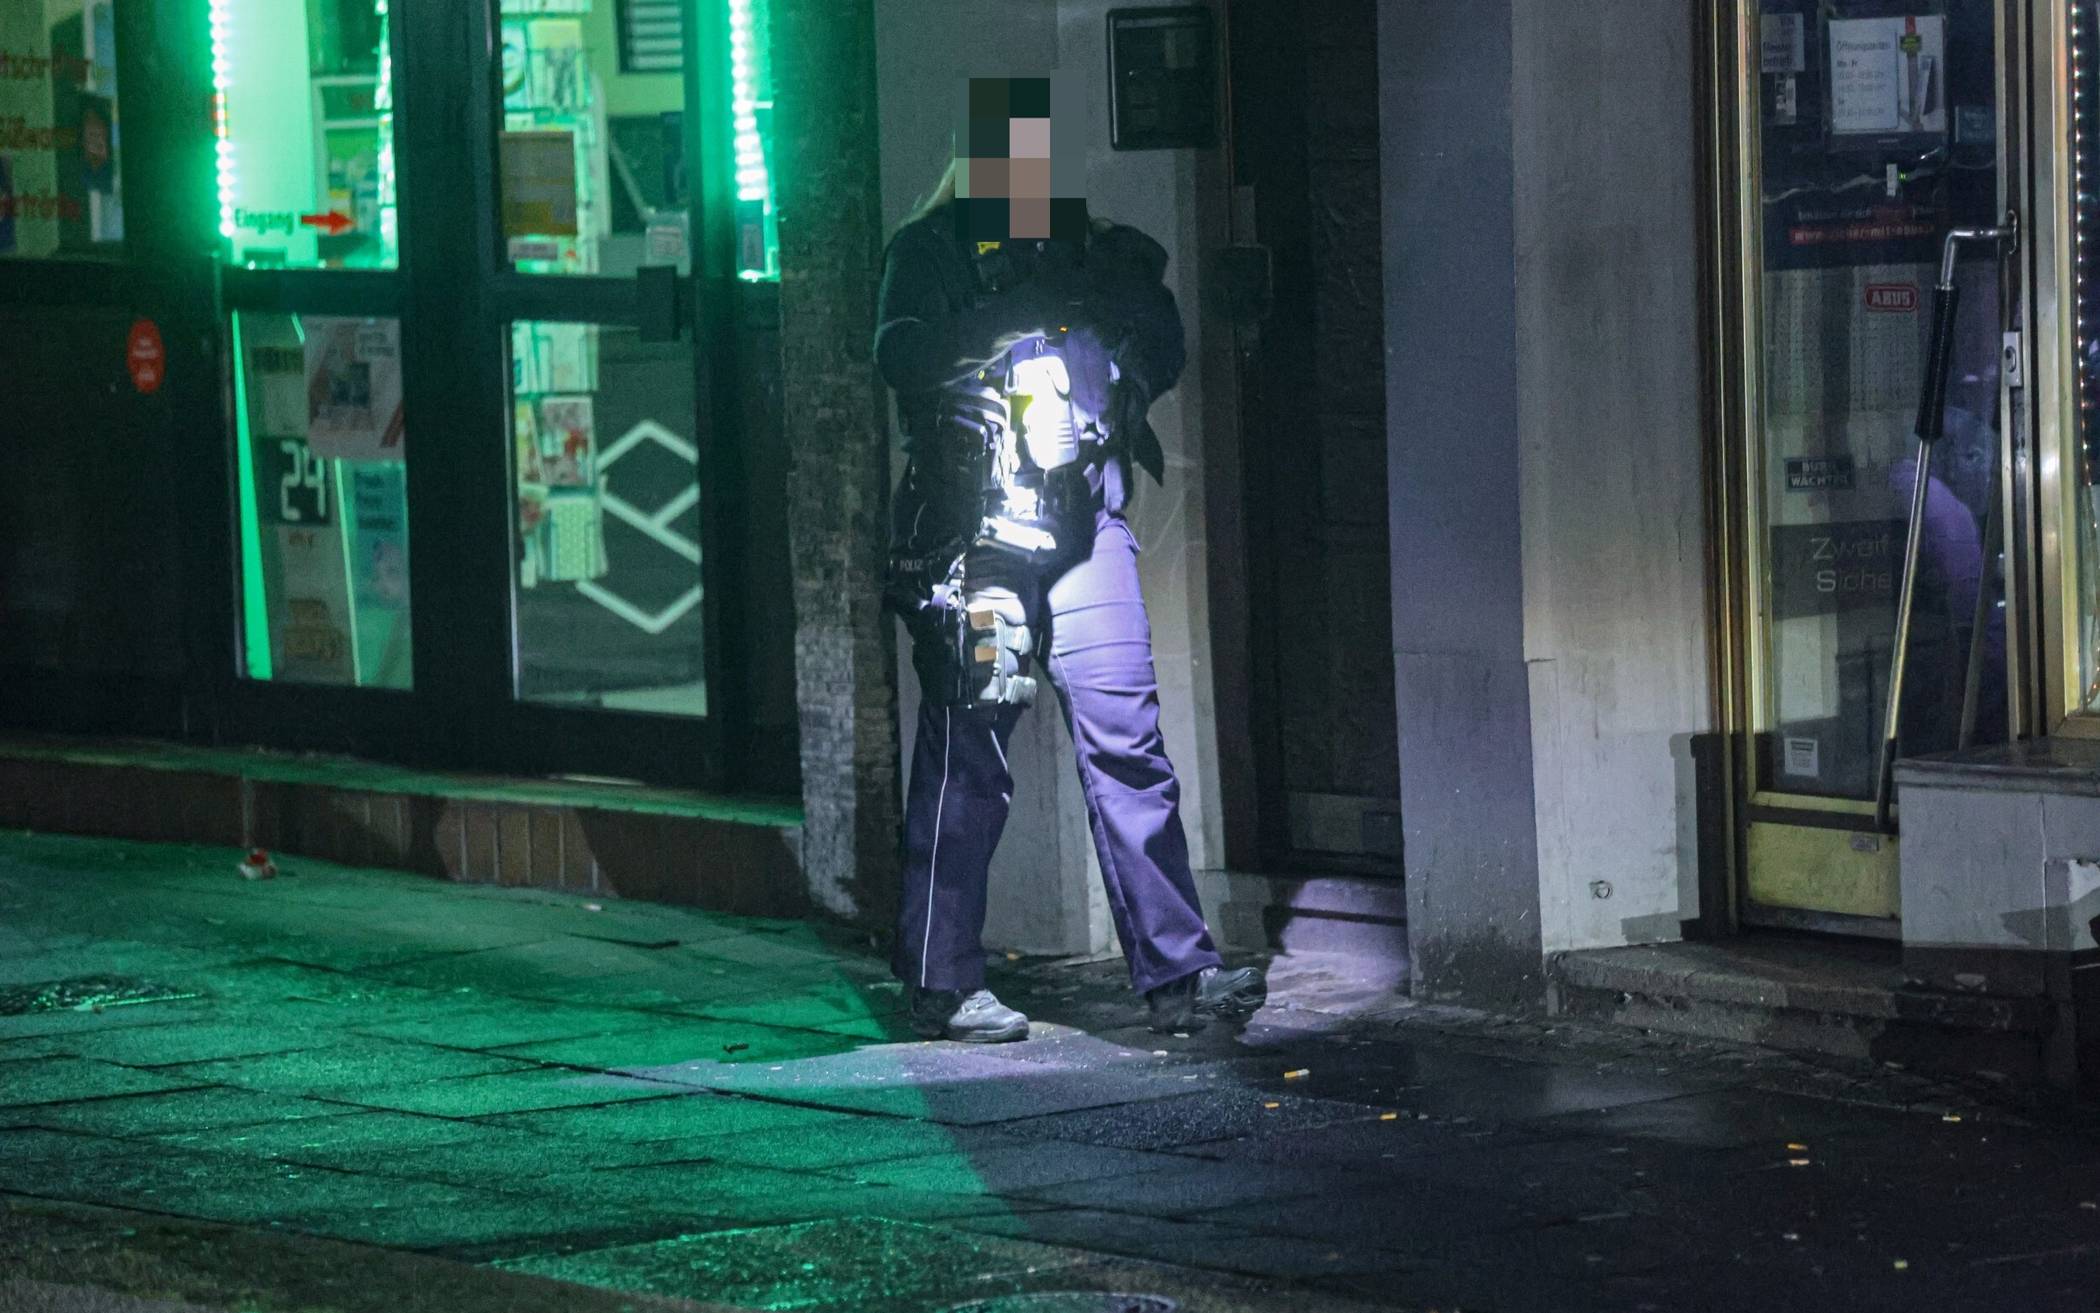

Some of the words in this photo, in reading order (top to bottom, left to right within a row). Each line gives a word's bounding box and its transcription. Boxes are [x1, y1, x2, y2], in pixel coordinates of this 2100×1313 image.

[235, 208, 294, 235] Eingang
[1872, 290, 1911, 306] ABUS
[1816, 568, 1892, 592] Siche
